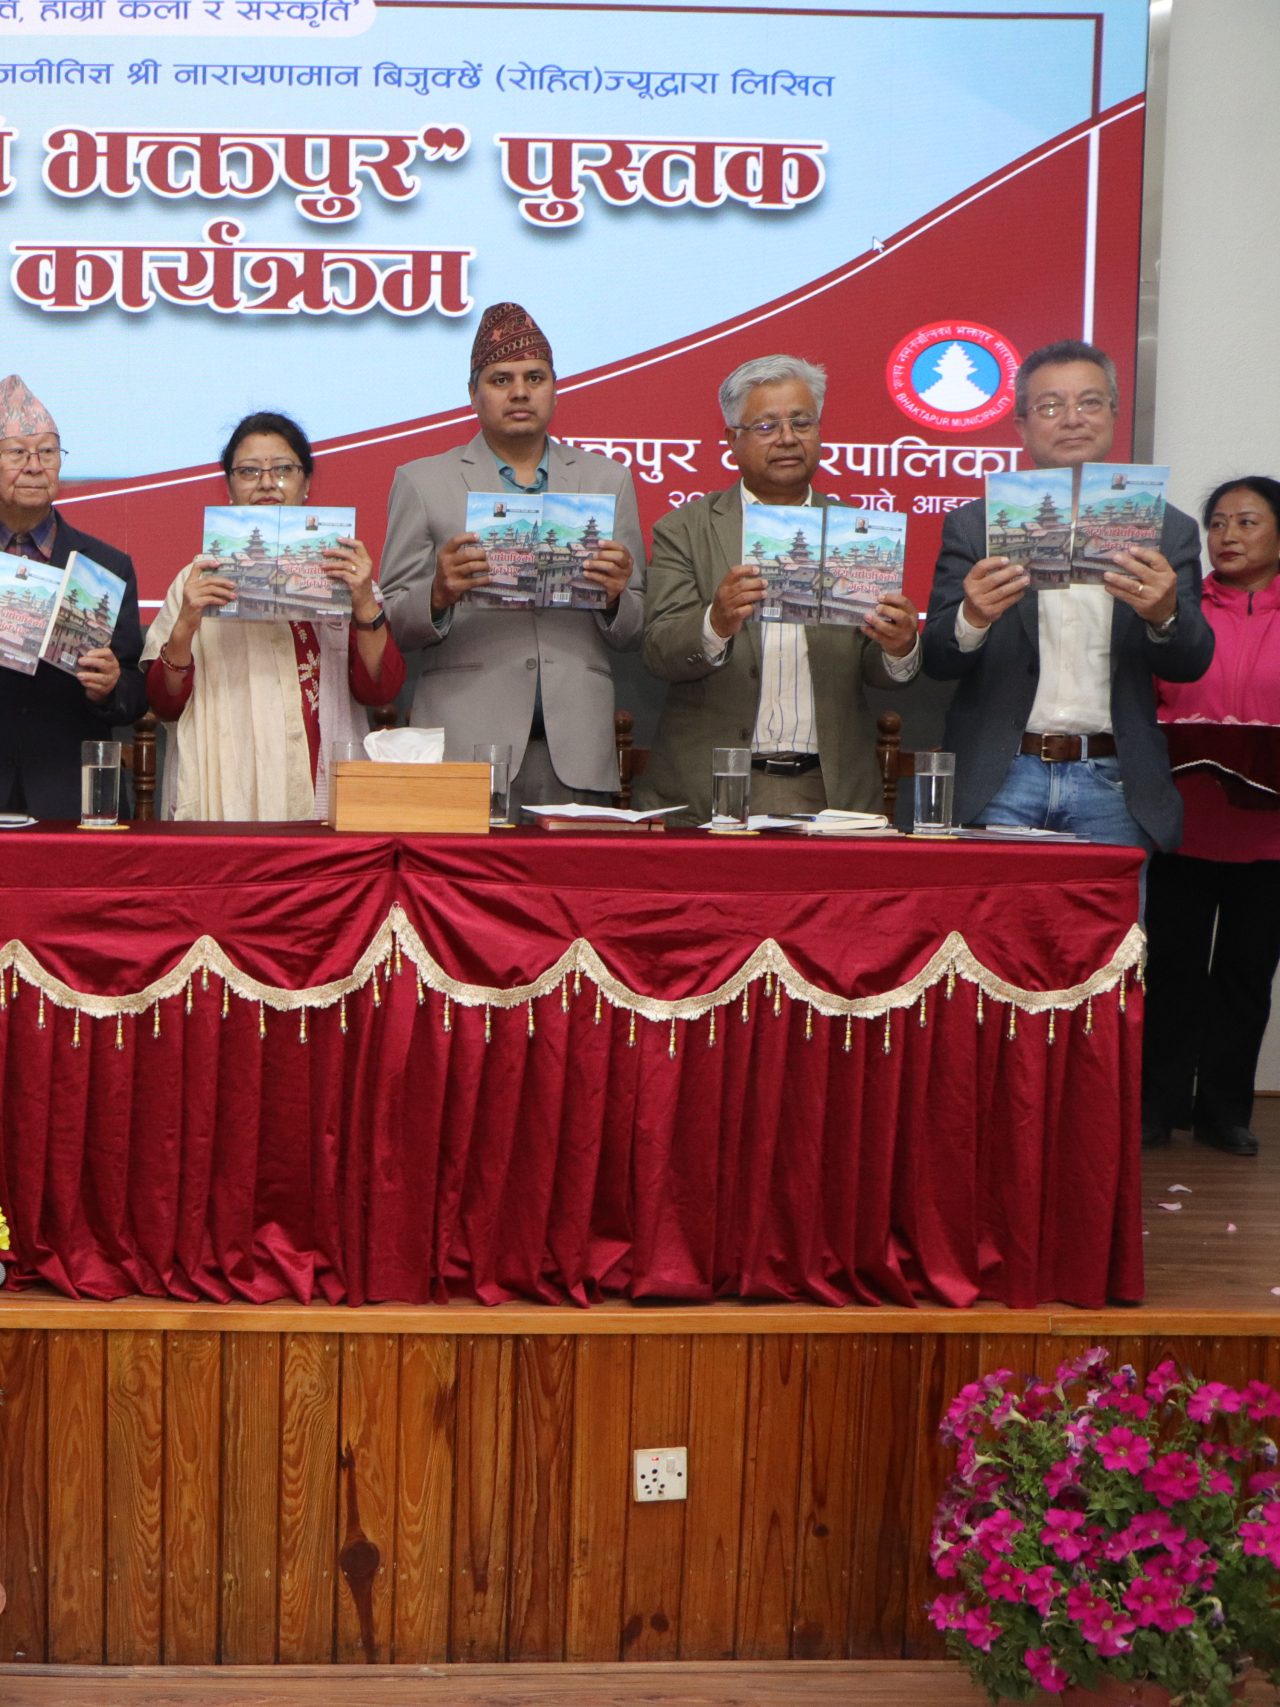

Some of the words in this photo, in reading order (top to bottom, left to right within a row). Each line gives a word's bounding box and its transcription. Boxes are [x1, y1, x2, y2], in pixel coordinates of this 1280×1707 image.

[118, 0, 192, 20] कला
[203, 0, 225, 20] र
[127, 58, 161, 85] श्री
[173, 63, 362, 88] नारायणमान
[731, 68, 836, 98] लिखित
[498, 138, 828, 223] पुस्तक
[11, 224, 475, 313] कार्यक्रम
[896, 392, 950, 426] BHAKTAPUR
[951, 395, 1012, 427] MUNICIPALITY
